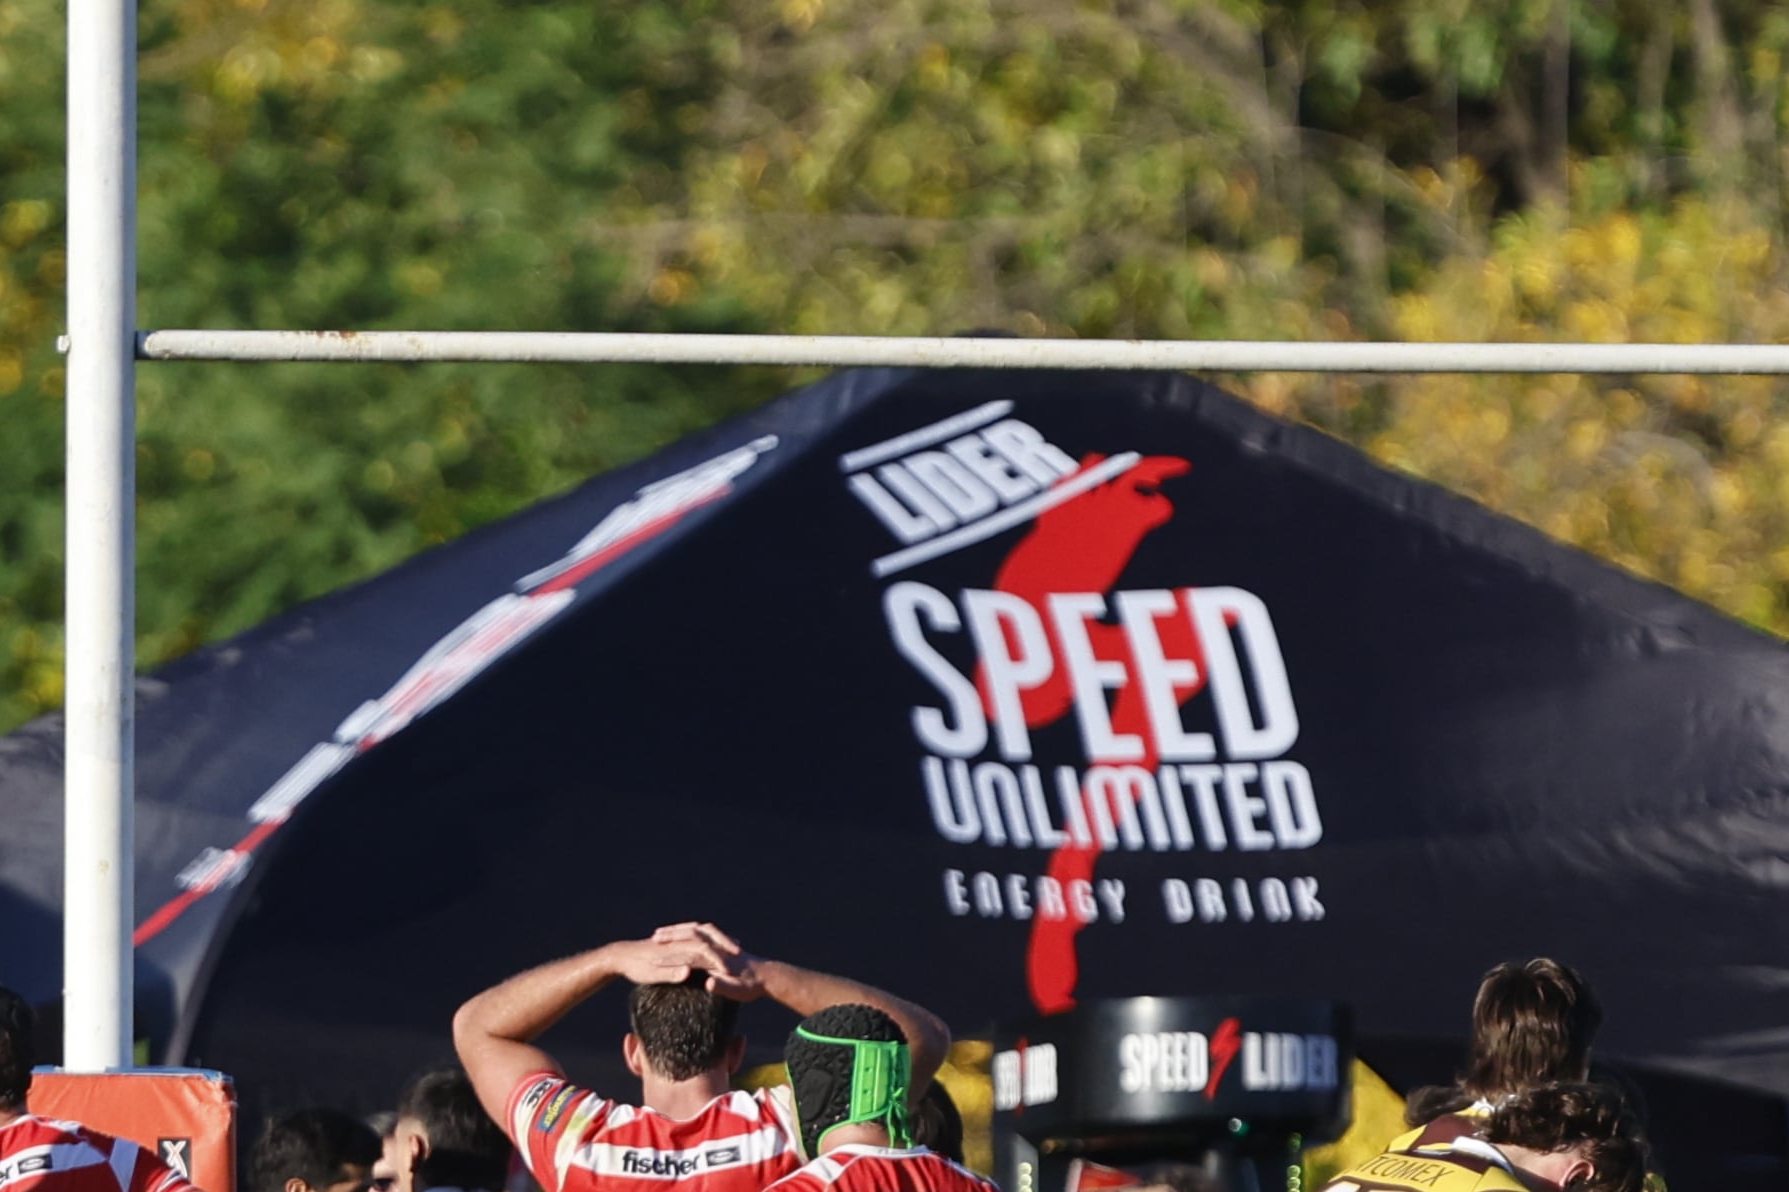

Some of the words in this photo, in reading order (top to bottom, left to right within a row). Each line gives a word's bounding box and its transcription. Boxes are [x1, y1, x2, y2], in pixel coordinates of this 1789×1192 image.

[849, 419, 1080, 544] LIDER
[883, 580, 1299, 762] SPEED
[922, 755, 1323, 851] UNLIMITED
[944, 867, 1126, 923] ENERGY
[1161, 875, 1326, 923] DRINK
[1119, 1031, 1210, 1094] SPEED
[1242, 1031, 1338, 1092] LIDER
[623, 1150, 700, 1176] fischer
[1356, 1155, 1456, 1188] TCOMEX
